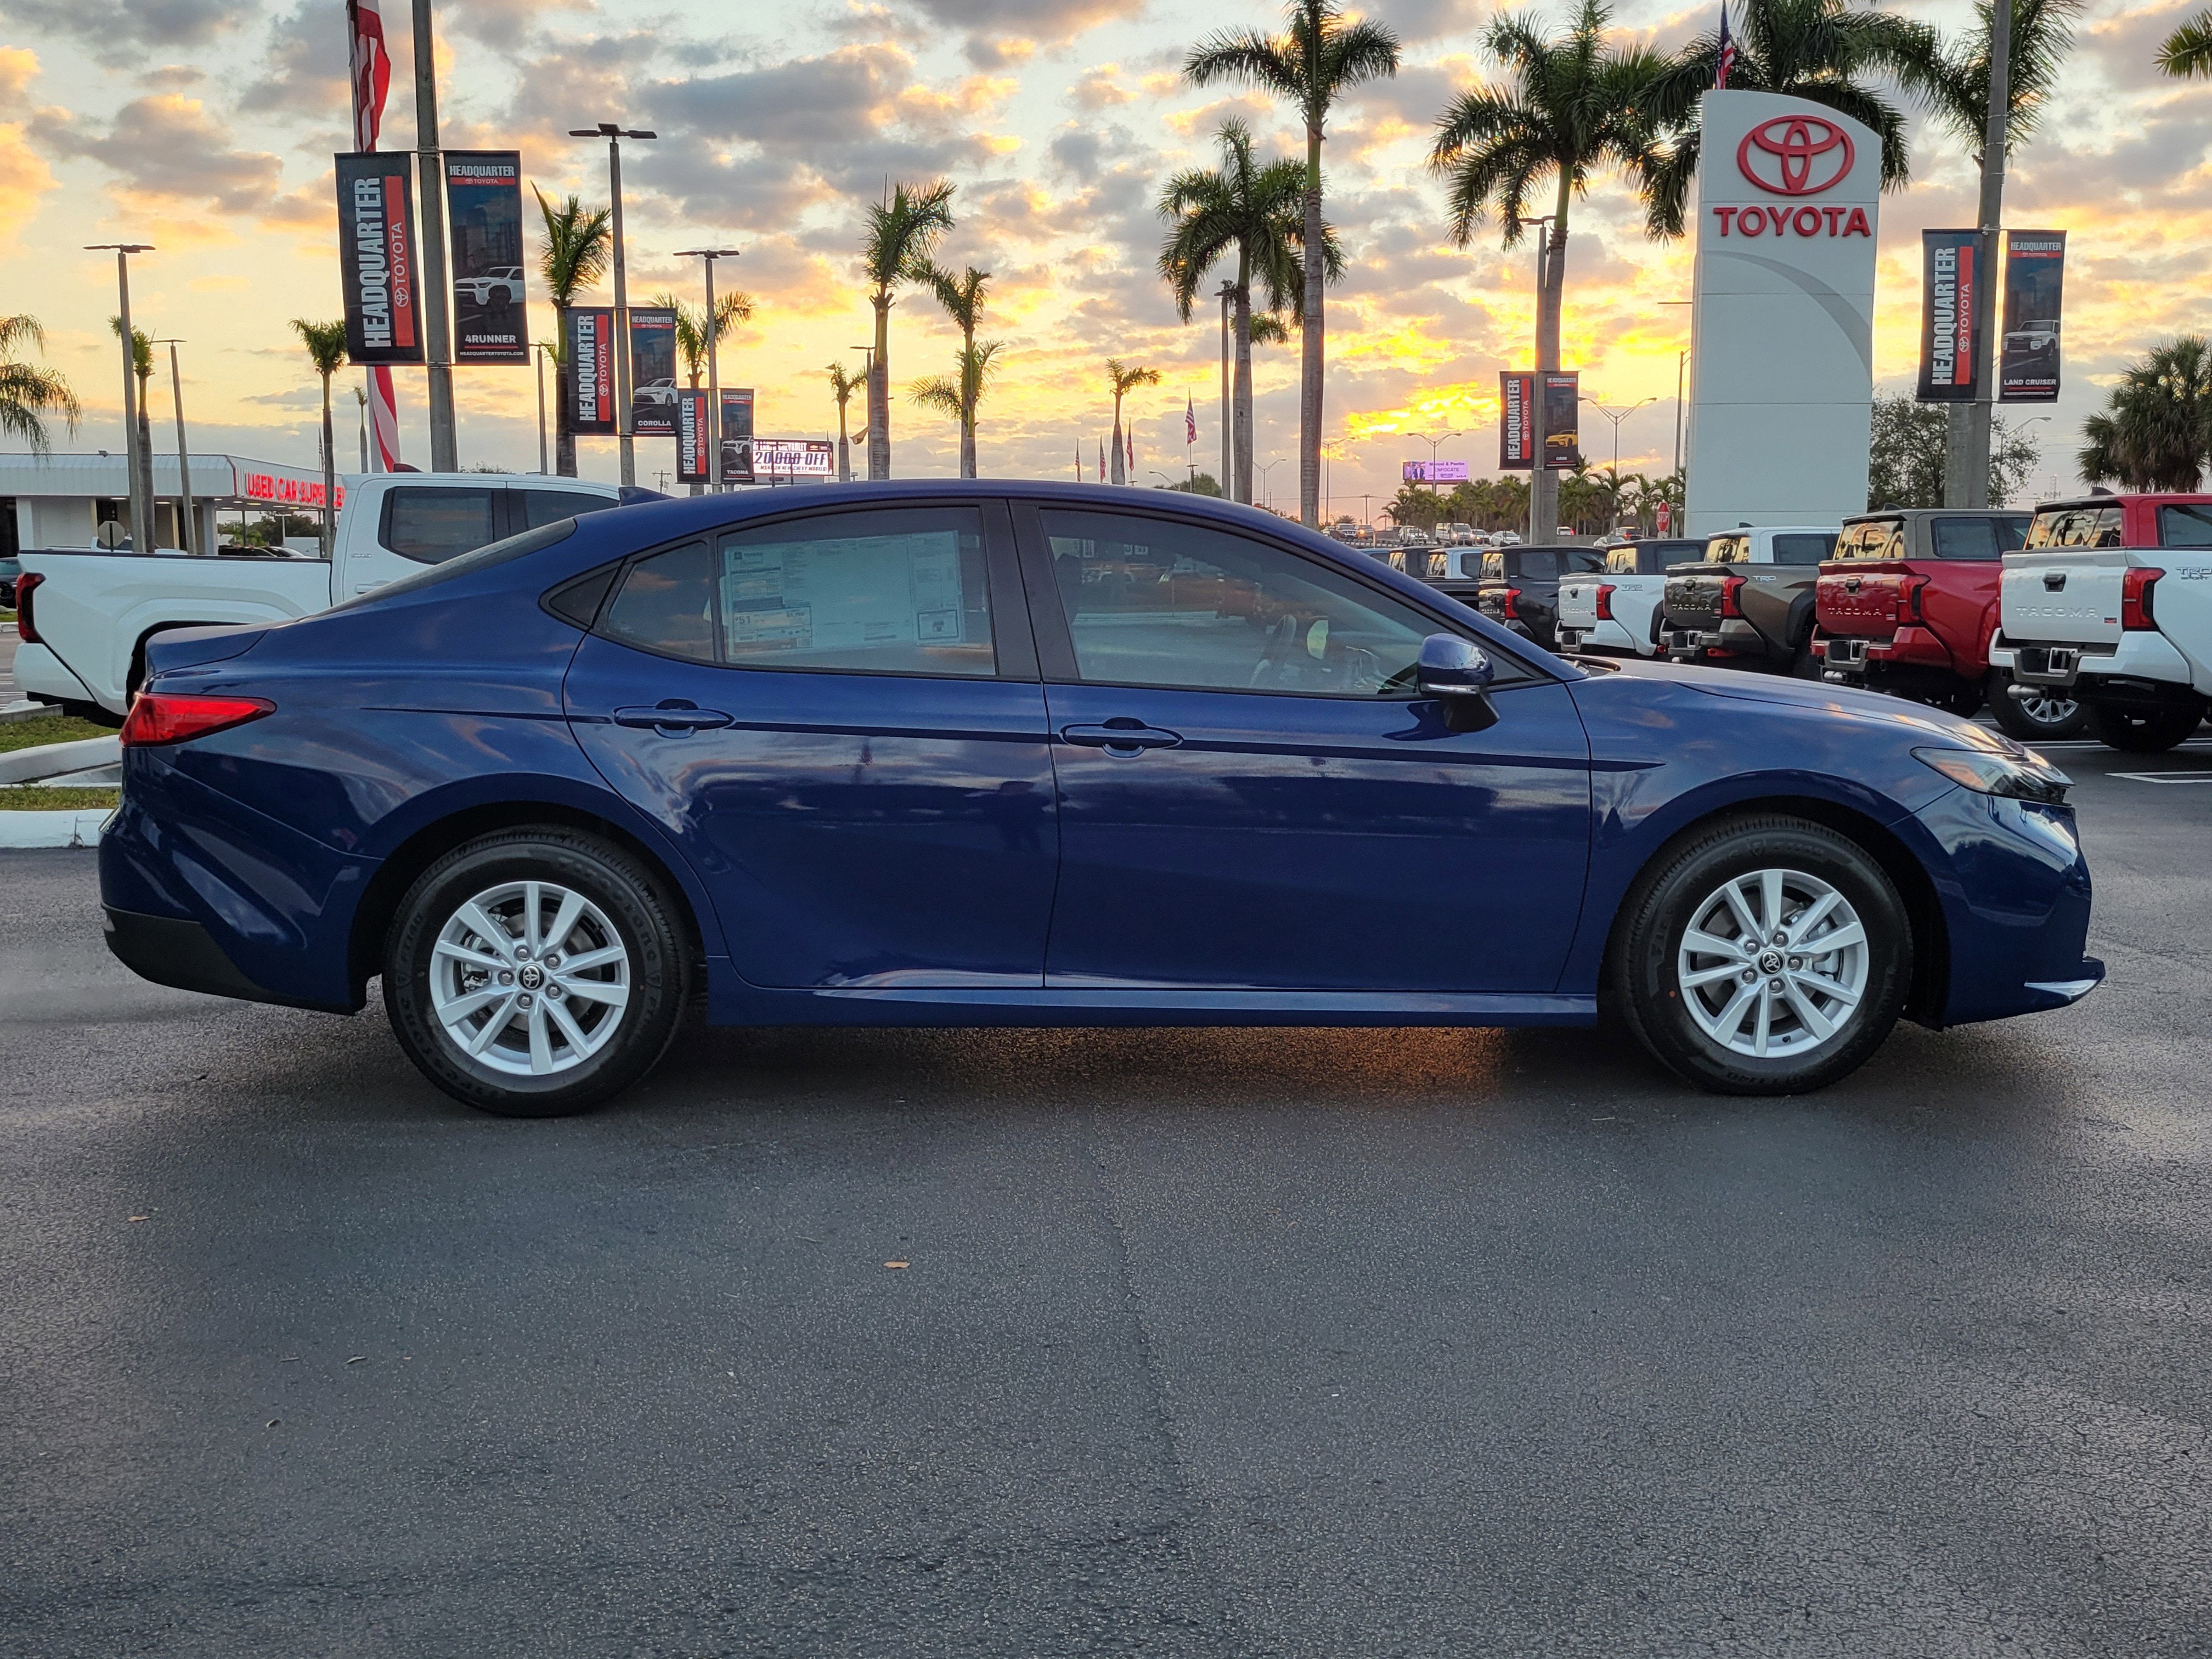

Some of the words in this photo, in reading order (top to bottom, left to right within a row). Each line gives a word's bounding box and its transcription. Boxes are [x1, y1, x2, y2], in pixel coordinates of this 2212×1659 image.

[449, 165, 515, 177] HEADQUARTER
[1713, 206, 1872, 237] TOYOTA
[354, 177, 392, 347] HEADQUARTER
[392, 222, 405, 285] TOYOTA
[2010, 242, 2061, 251] HEADQUARTER
[1931, 248, 1957, 384] HEADQUARTER
[1960, 284, 1970, 335] TOYOTA
[465, 335, 516, 343] 4RUNNER
[578, 315, 597, 421] HEADQUARTER
[1508, 379, 1522, 460] HEADQUARTER
[682, 398, 696, 474] HEADQUARTER
[805, 453, 827, 465] OFF
[247, 472, 274, 499] USED
[277, 477, 297, 501] CAR
[1827, 607, 1882, 616] TACOMA
[2016, 607, 2098, 617] TACOMA
